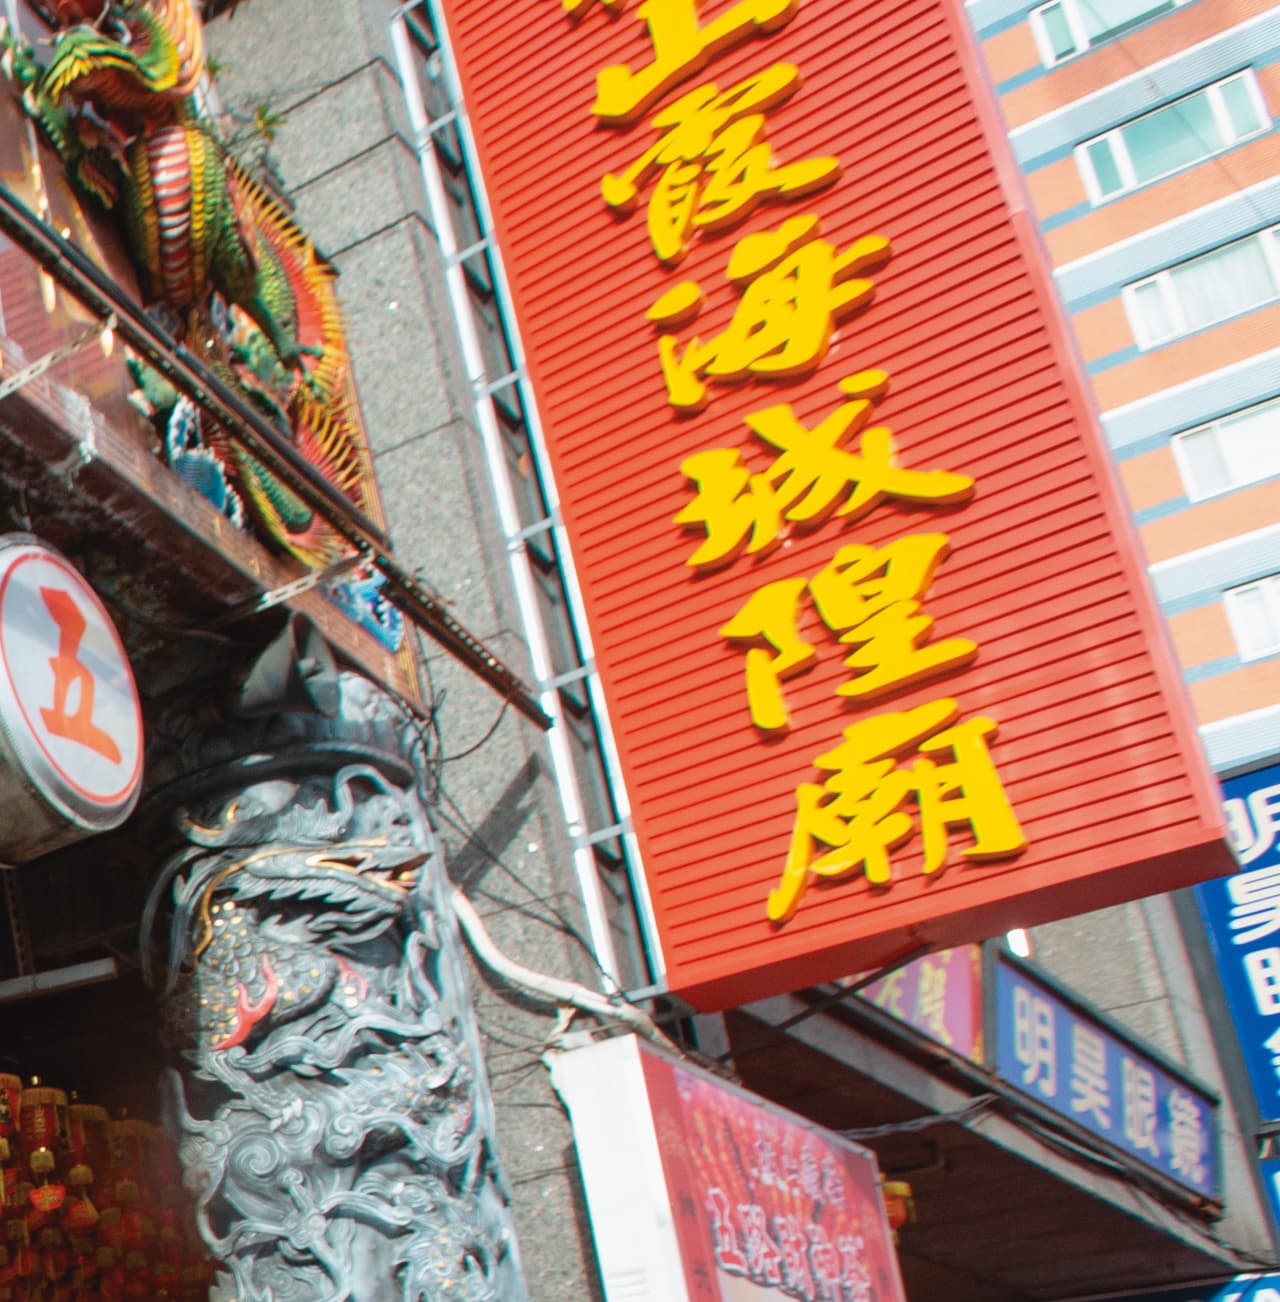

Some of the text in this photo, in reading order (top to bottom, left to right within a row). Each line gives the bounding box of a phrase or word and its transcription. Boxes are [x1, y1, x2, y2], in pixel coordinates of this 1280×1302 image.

[40, 588, 123, 766] 五
[561, 0, 1027, 924] 山霞海城隍廟
